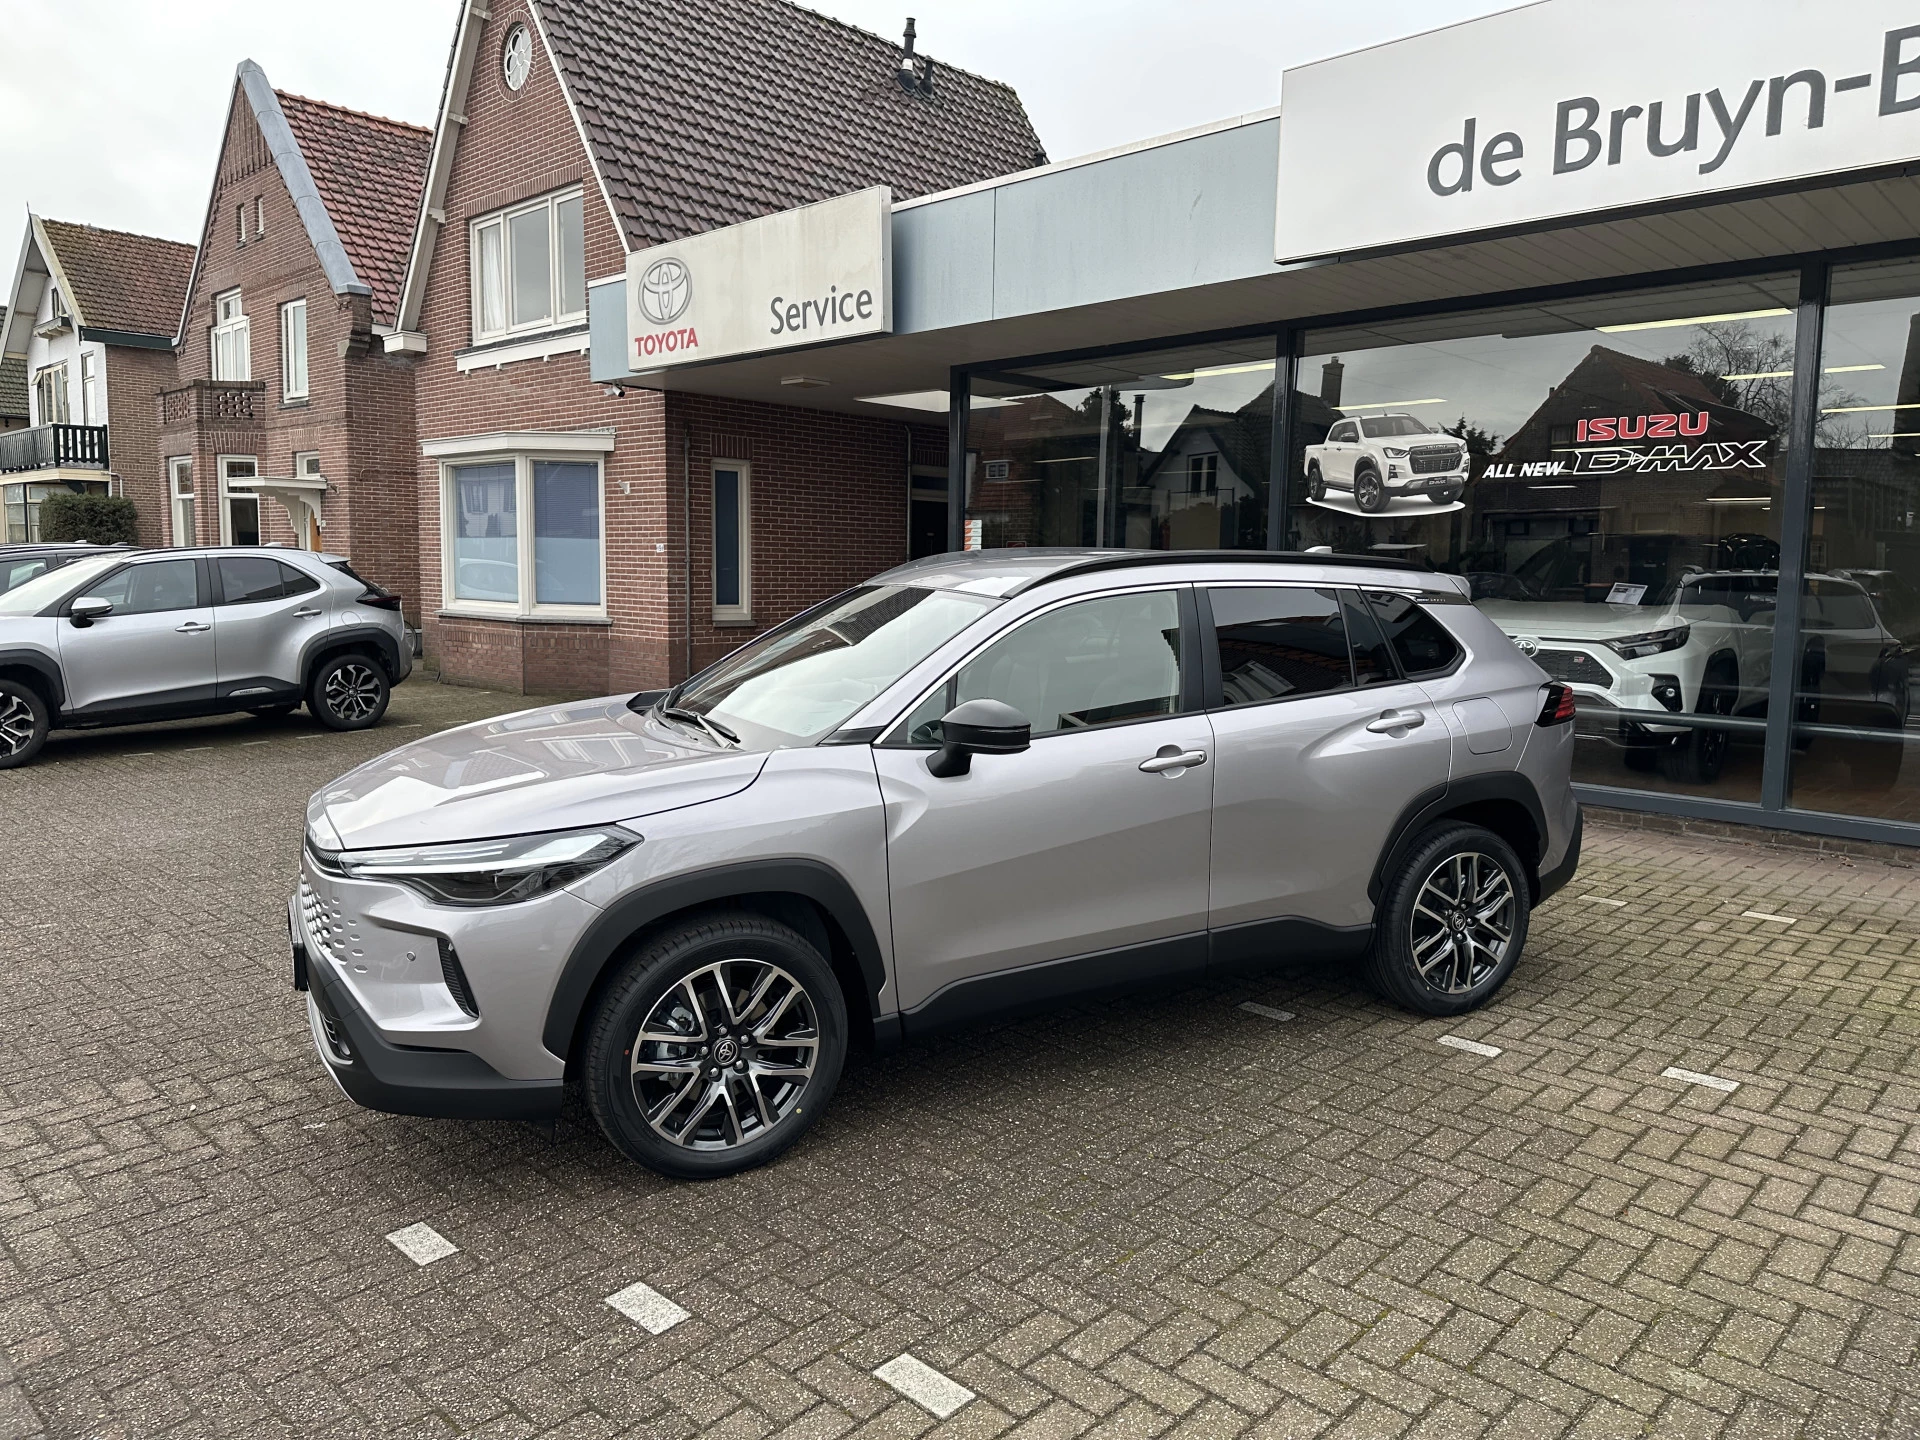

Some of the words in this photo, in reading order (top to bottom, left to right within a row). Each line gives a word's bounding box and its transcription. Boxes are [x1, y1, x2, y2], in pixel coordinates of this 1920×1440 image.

[1427, 118, 1524, 197] de
[1553, 24, 1920, 175] Bruyn-B
[770, 285, 873, 335] Service
[634, 327, 699, 357] TOYOTA
[1576, 411, 1709, 442] ISUZU
[1482, 463, 1515, 479] ALL
[1518, 460, 1565, 478] NEW
